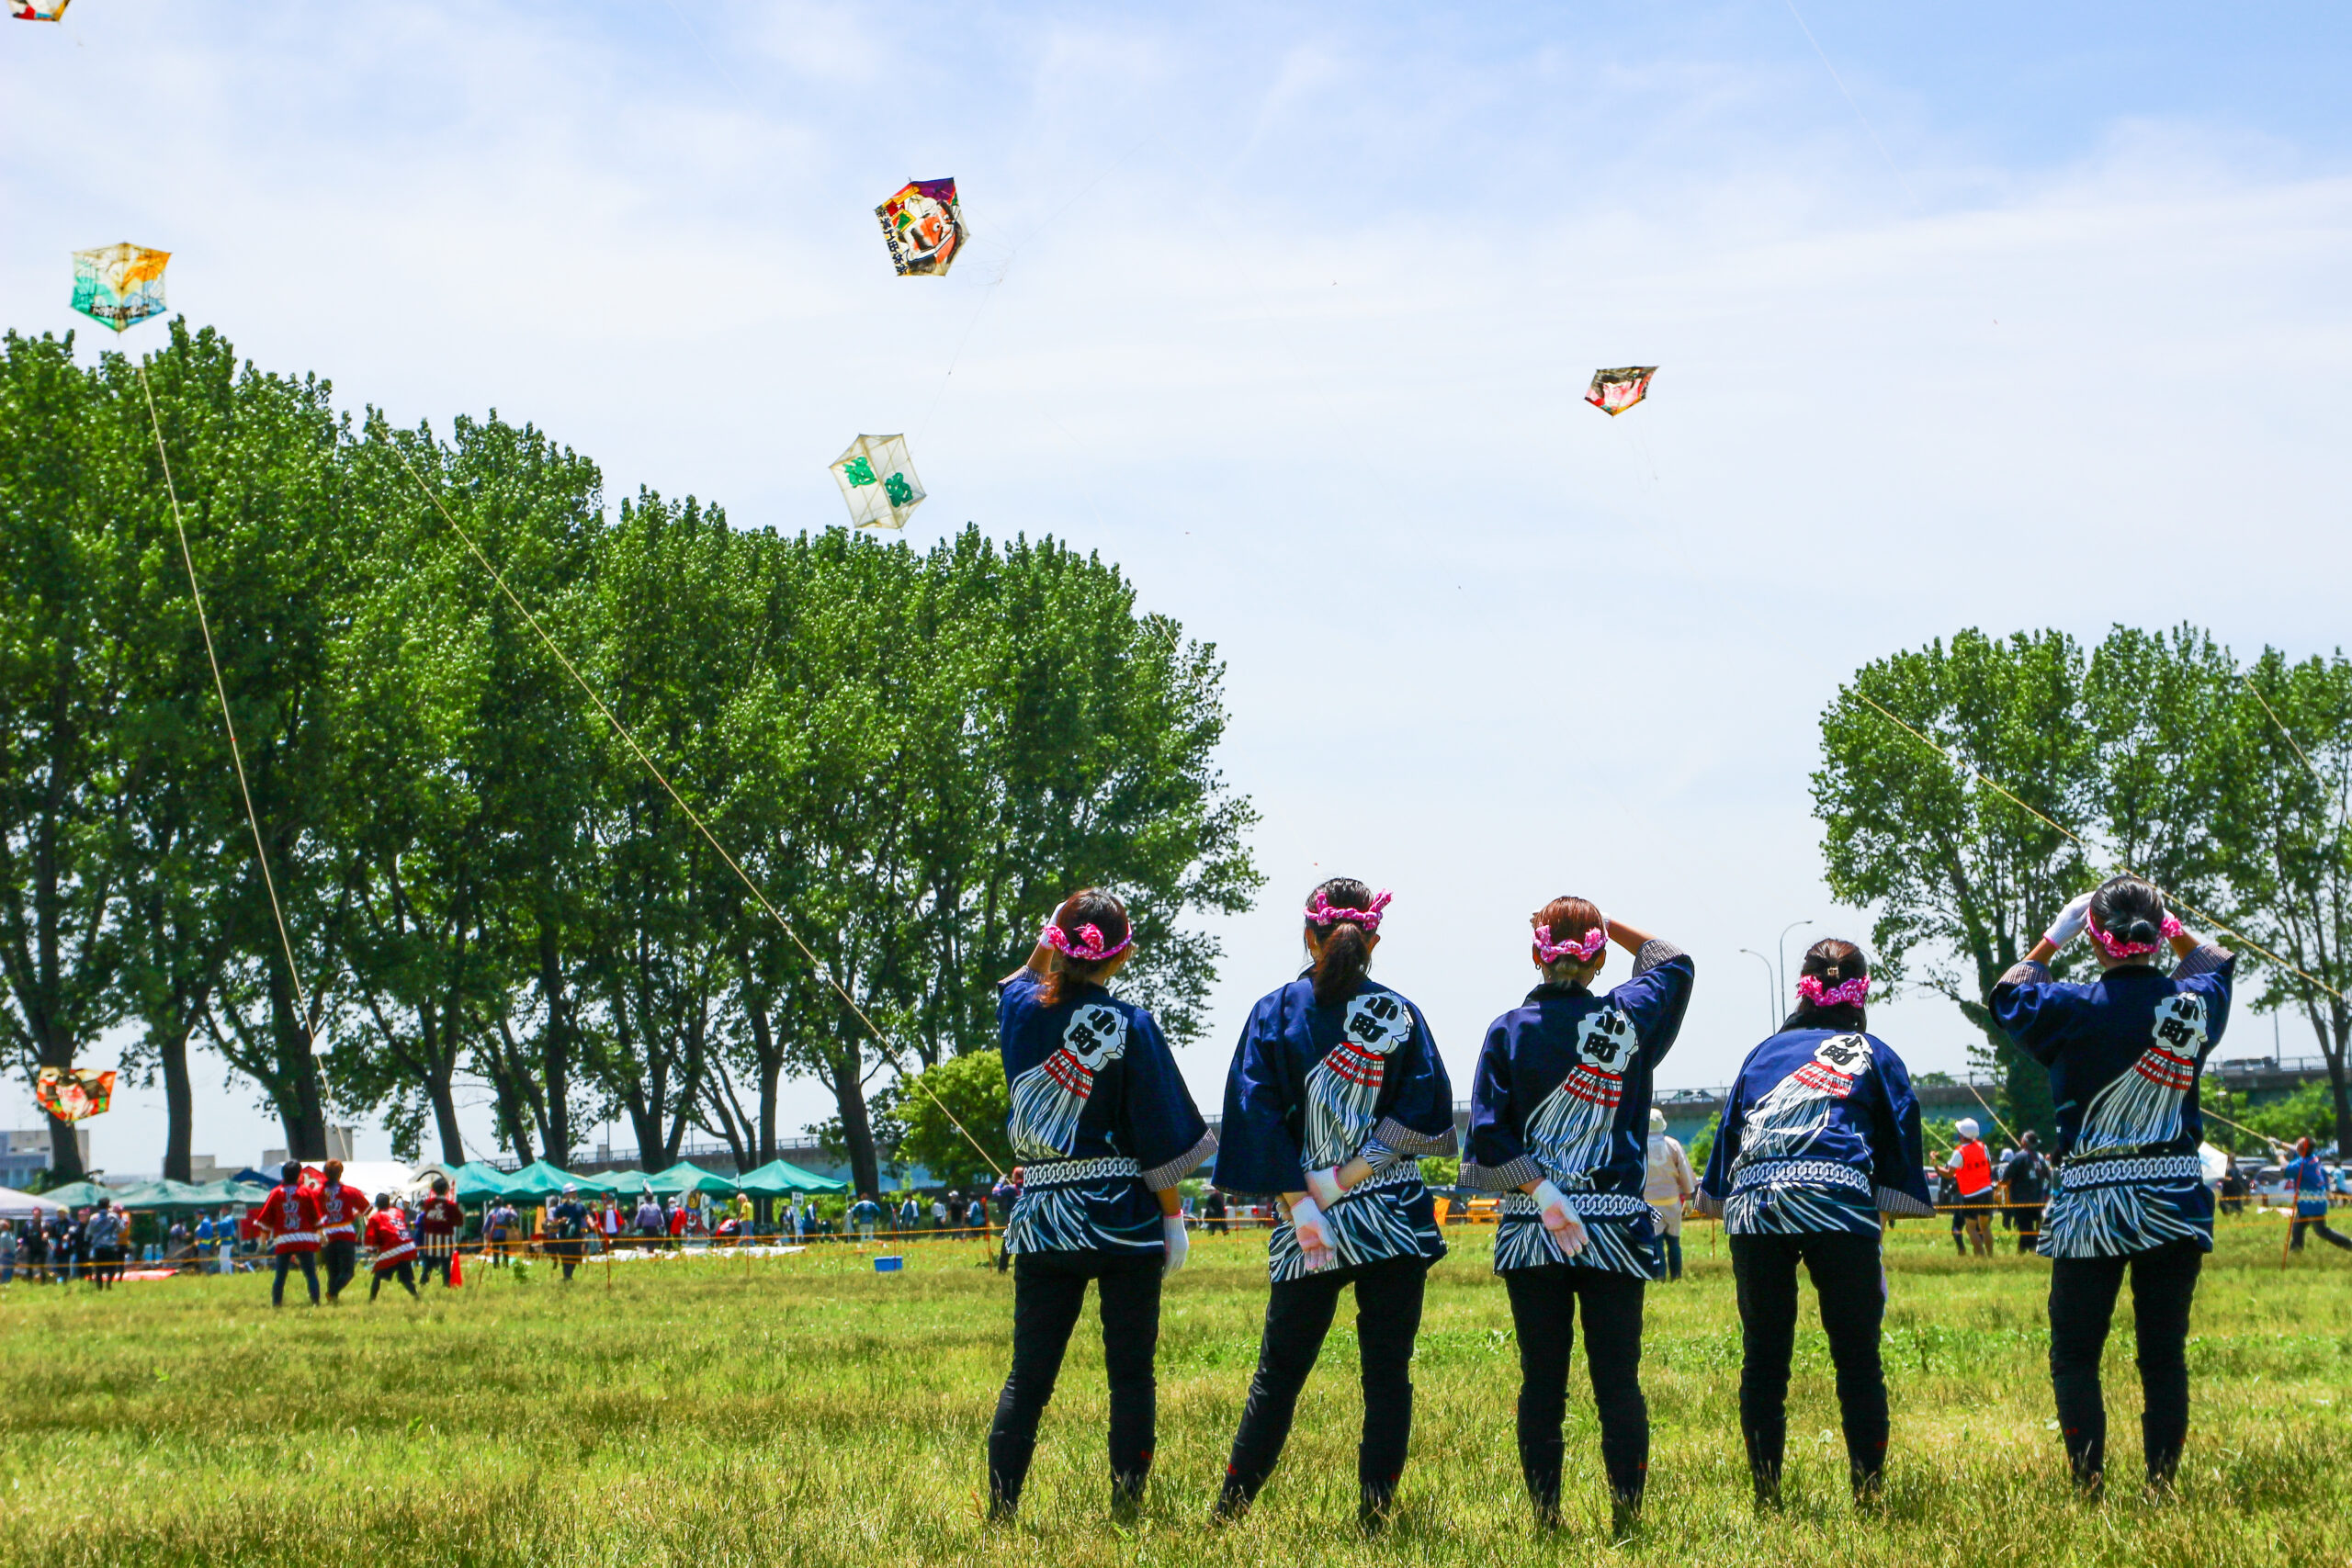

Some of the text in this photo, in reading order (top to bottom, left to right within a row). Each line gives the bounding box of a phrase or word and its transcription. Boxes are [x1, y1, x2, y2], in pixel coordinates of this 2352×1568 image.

[1069, 1008, 1117, 1056] 小町
[1350, 996, 1398, 1043] 小町
[1583, 1011, 1626, 1063] 小町
[2158, 998, 2199, 1047] 小町
